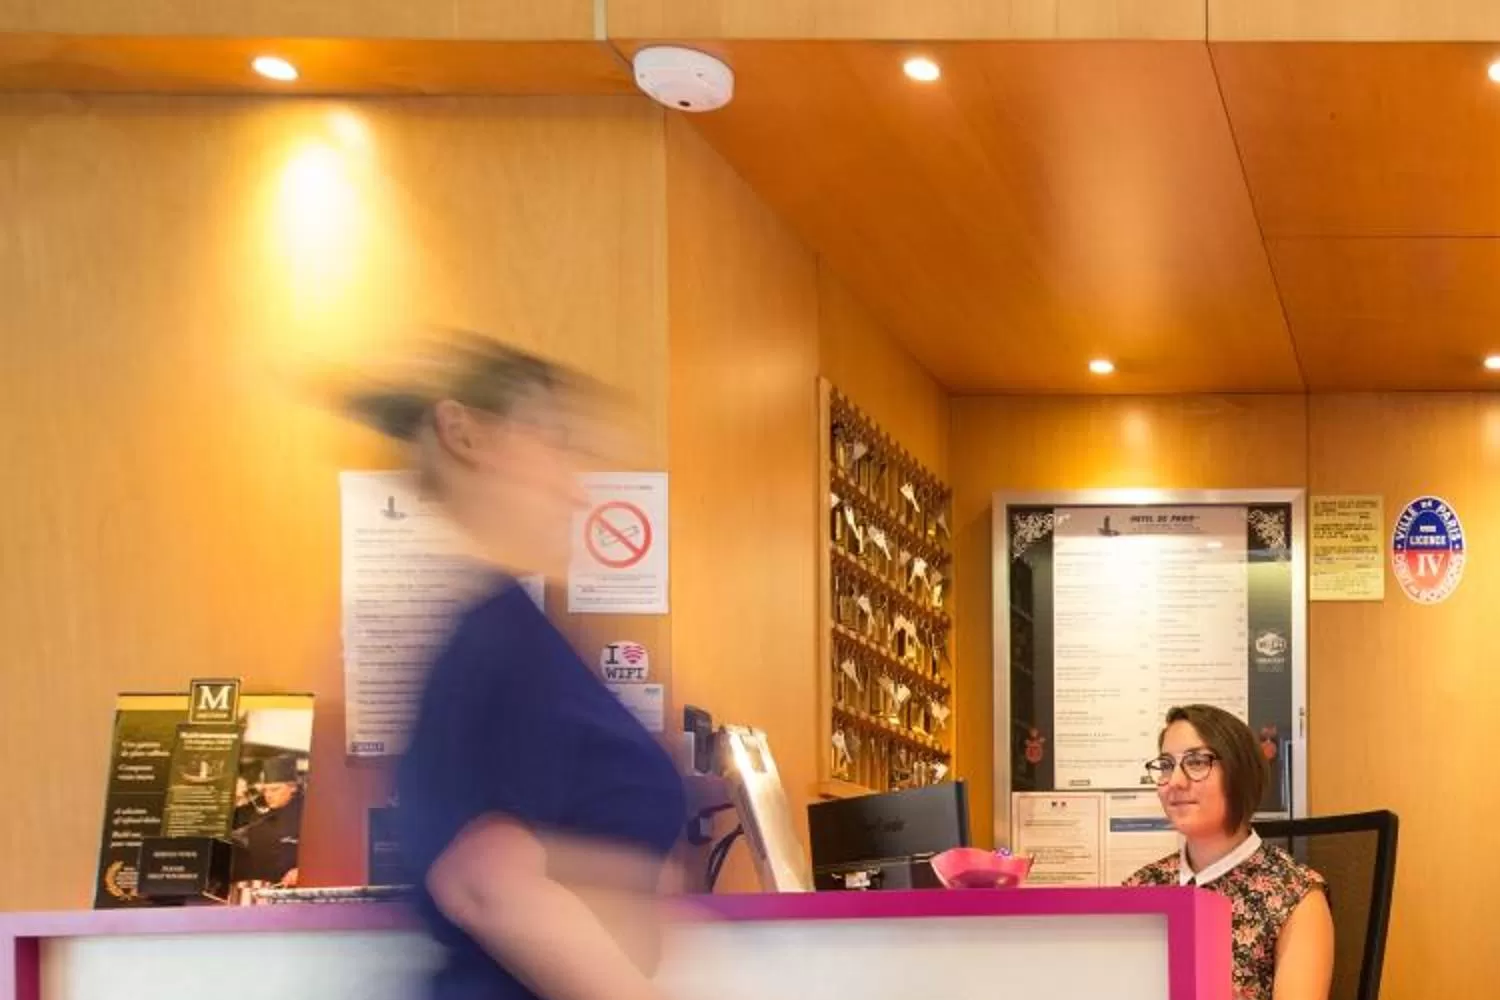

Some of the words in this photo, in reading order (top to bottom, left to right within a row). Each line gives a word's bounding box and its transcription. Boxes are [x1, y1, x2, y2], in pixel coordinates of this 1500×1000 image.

[1395, 505, 1418, 540] VILLE
[1436, 503, 1461, 541] PARIS
[1415, 553, 1445, 576] IV
[604, 644, 620, 665] I
[197, 684, 232, 711] M
